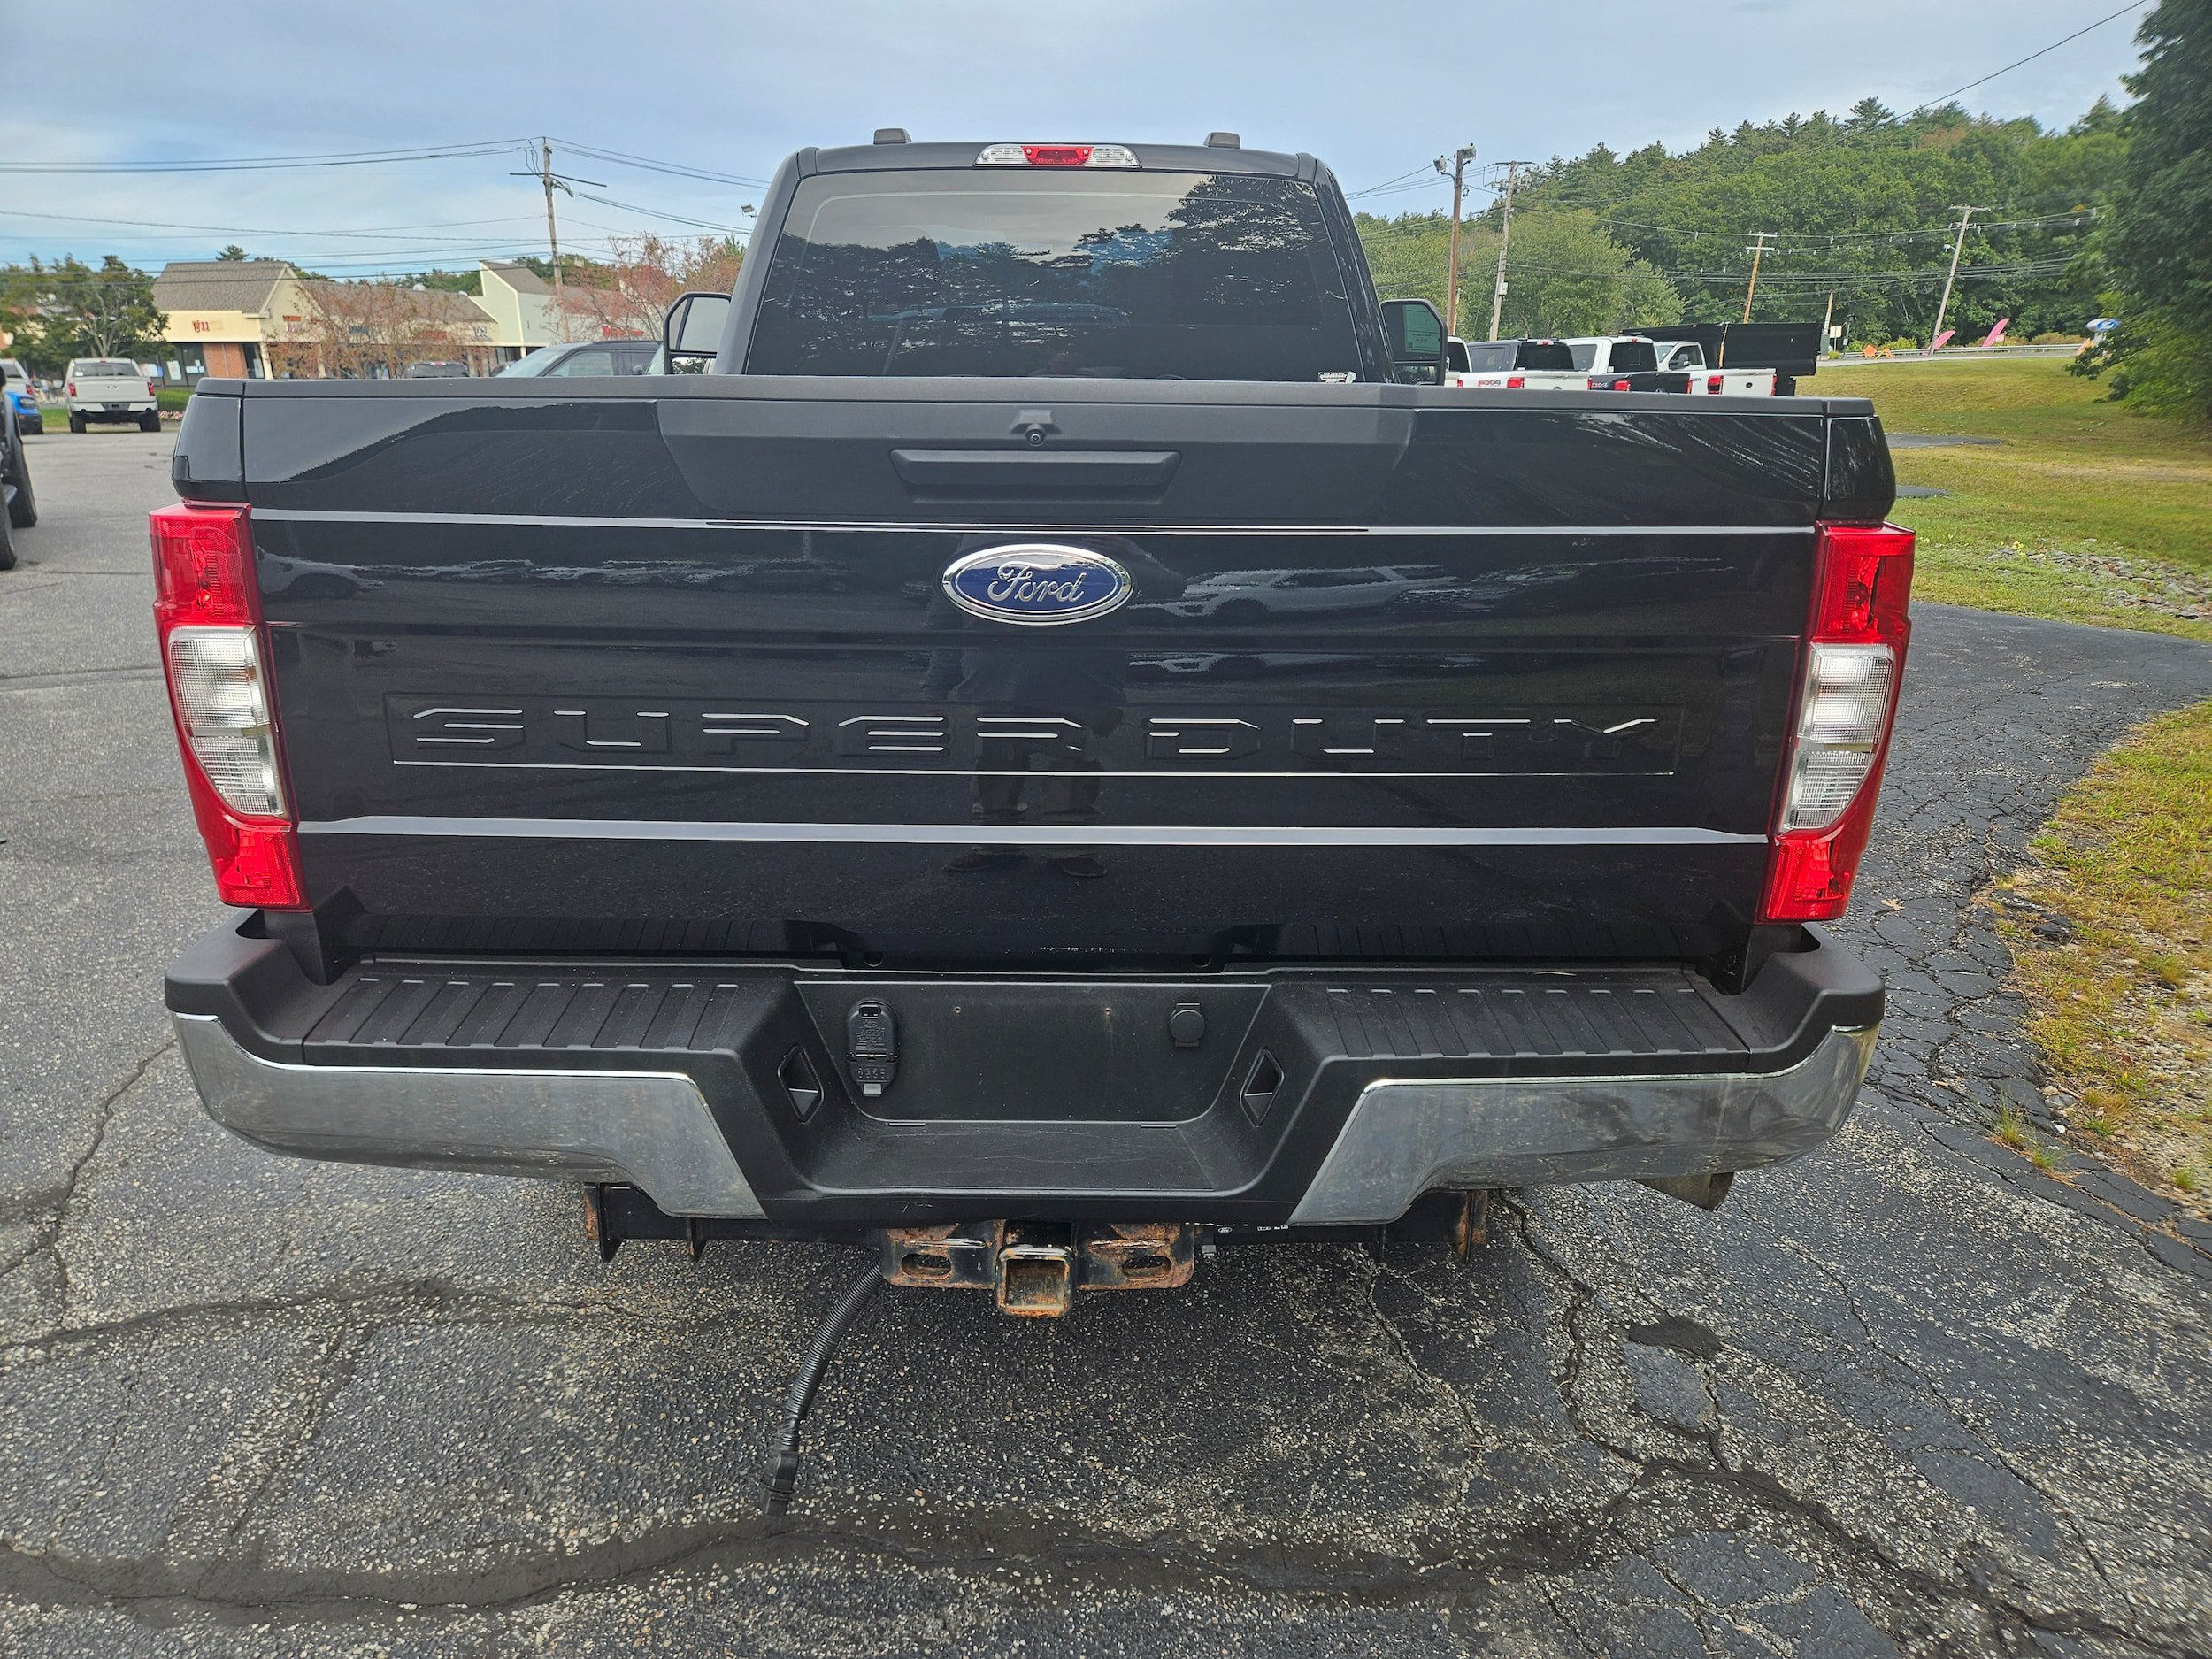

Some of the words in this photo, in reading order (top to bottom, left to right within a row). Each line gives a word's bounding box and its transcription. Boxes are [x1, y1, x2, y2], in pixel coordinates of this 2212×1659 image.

[987, 560, 1087, 603] Ford
[411, 707, 1086, 758] SUPER
[1143, 718, 1659, 761] DUTY
